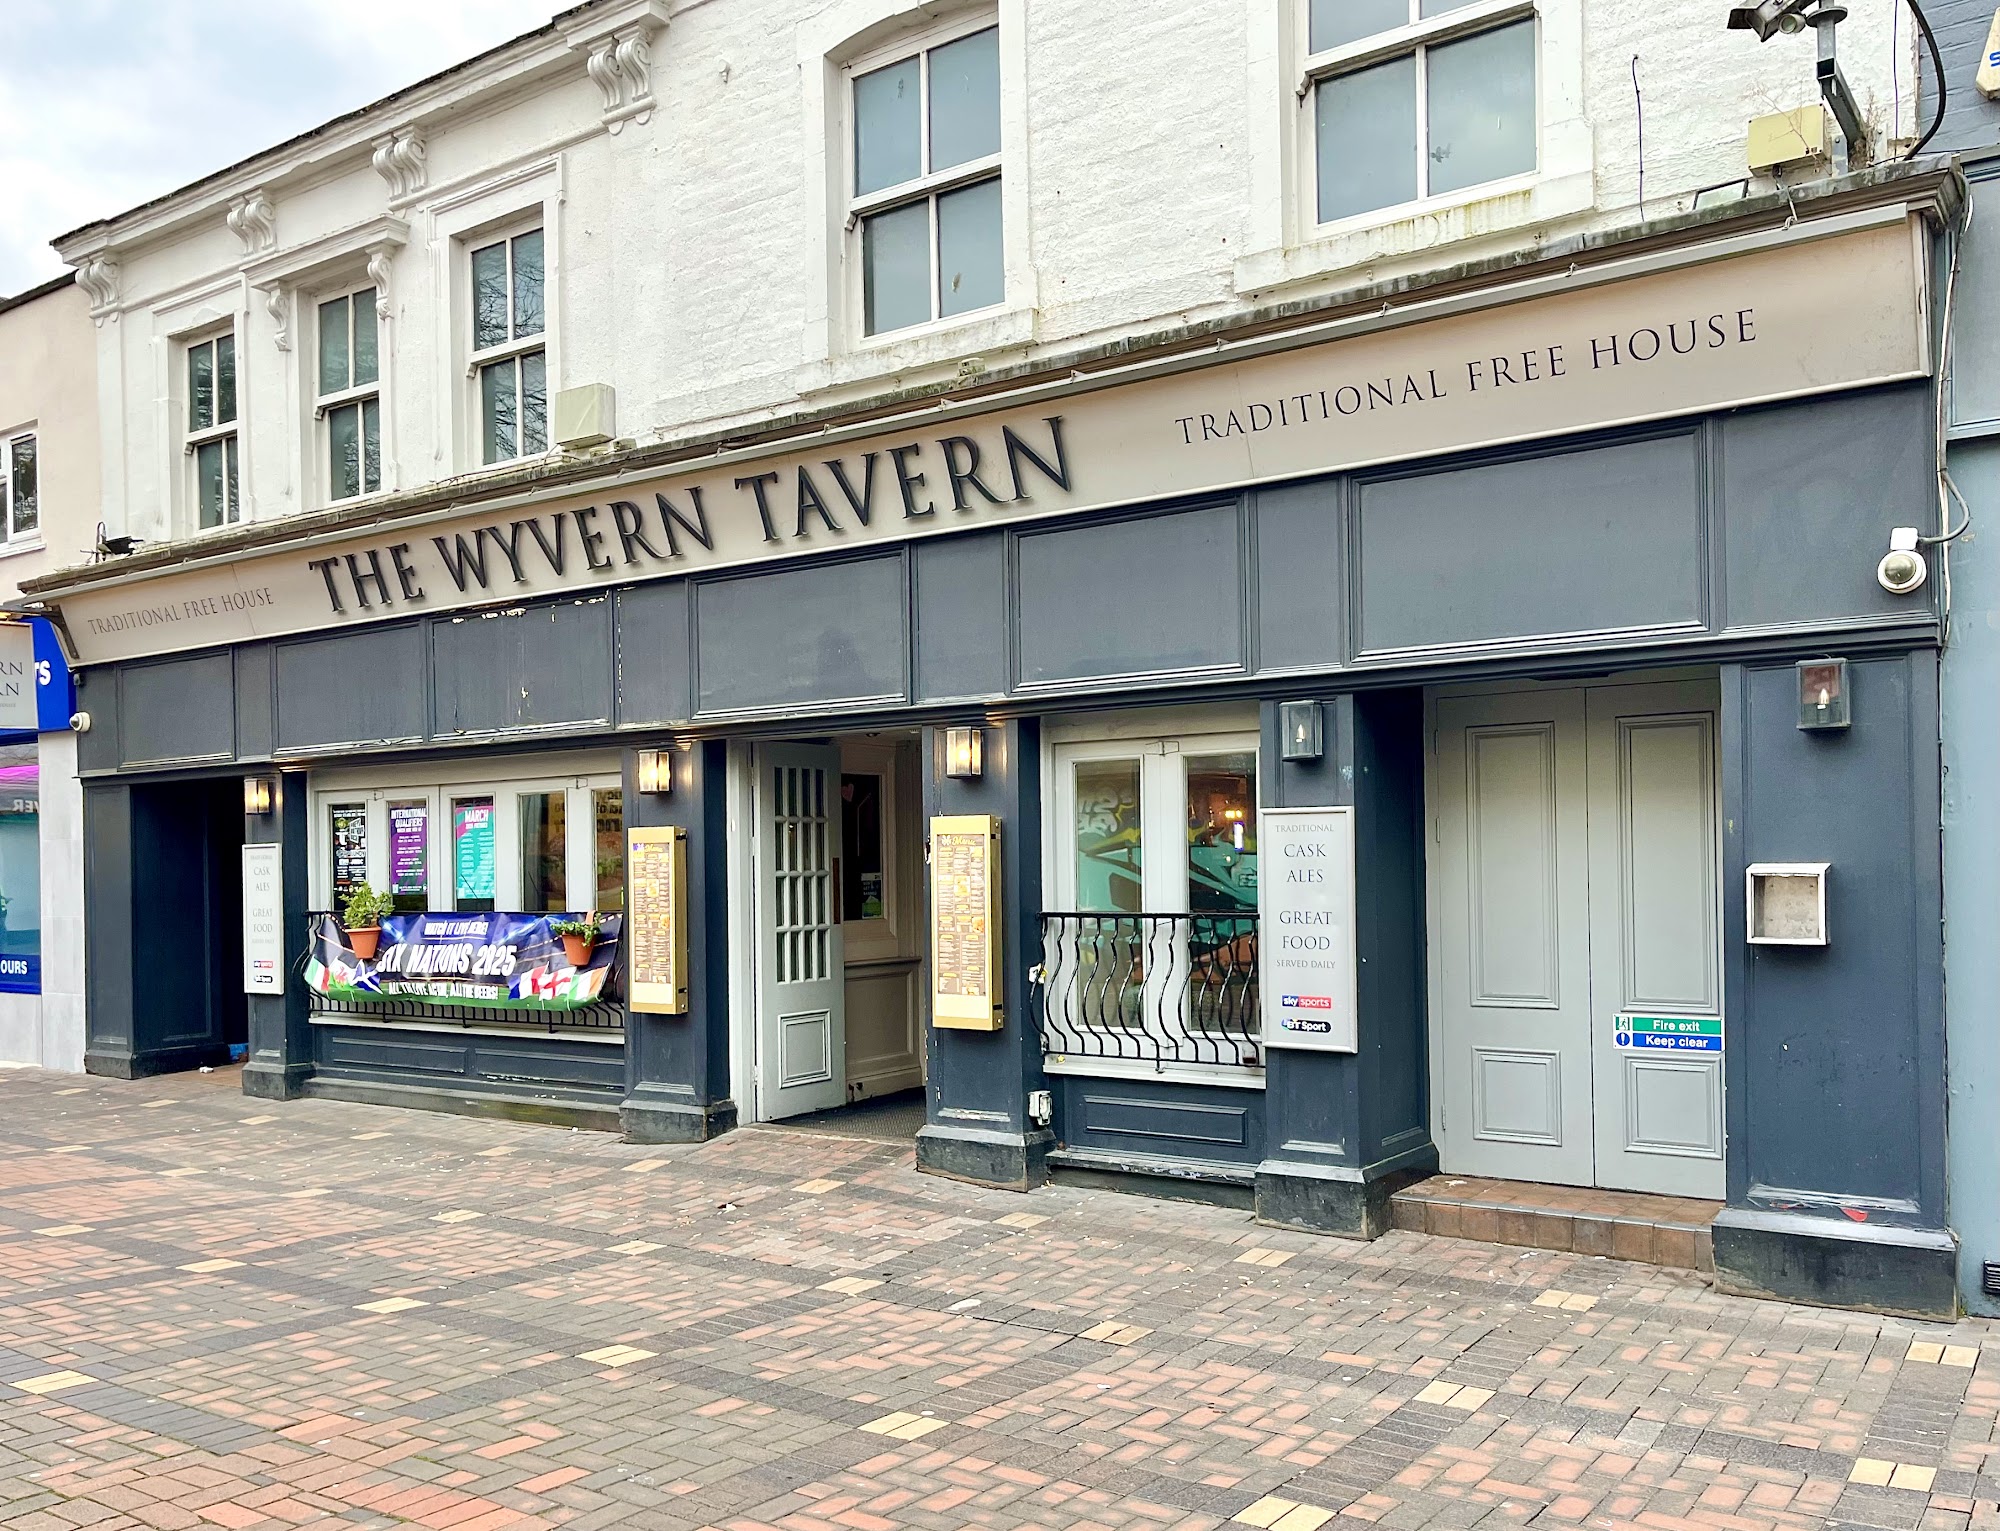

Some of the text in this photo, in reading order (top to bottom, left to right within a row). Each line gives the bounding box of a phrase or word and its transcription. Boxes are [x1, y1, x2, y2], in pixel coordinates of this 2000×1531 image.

[1175, 308, 1757, 445] TRADITIONAL FREE HOUSE
[307, 415, 1072, 614] THE WYVERN TAVERN
[88, 587, 274, 635] TRADITIONAL FREE HOUSE
[465, 809, 488, 823] MARCH
[1275, 824, 1335, 833] TRADITIONAL
[1284, 844, 1326, 858] CASK
[1287, 869, 1323, 883] ALES
[1279, 911, 1332, 925] GREAT
[253, 924, 273, 932] FOOD
[1282, 936, 1330, 950] FOOD
[406, 943, 473, 974] NATIONS
[473, 945, 517, 976] 2025
[1276, 959, 1336, 969] SERVED DAILY
[1283, 996, 1330, 1008] sky sports
[1287, 1020, 1326, 1031] BT Sport
[1653, 1020, 1700, 1031] Fire exit
[1645, 1035, 1708, 1048] Keep clear
